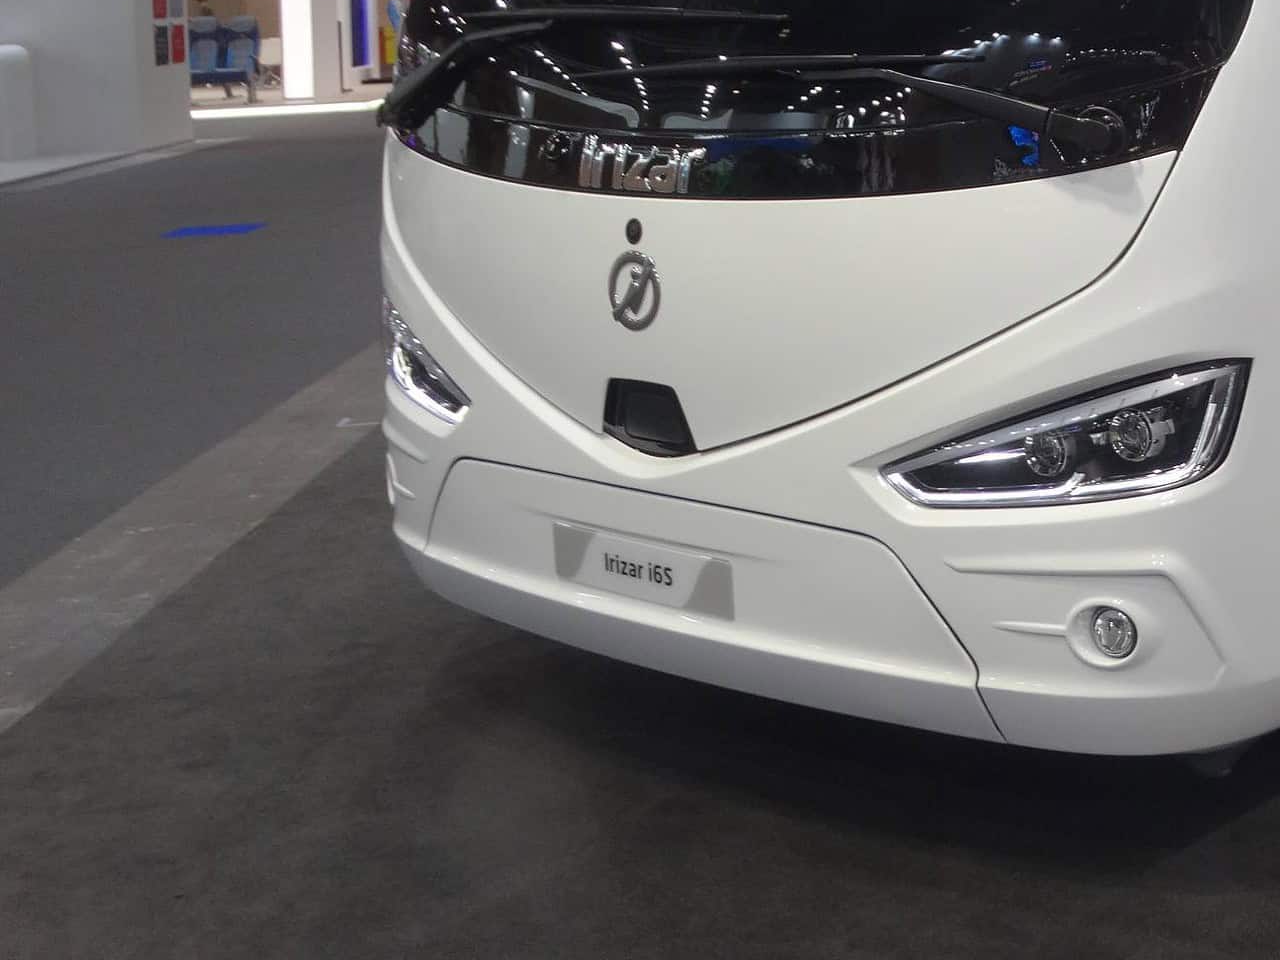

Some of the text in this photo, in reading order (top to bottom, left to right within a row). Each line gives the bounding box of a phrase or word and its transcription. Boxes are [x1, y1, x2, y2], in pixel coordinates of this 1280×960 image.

[578, 134, 707, 194] Irizar
[604, 552, 673, 587] Irizar i6S
